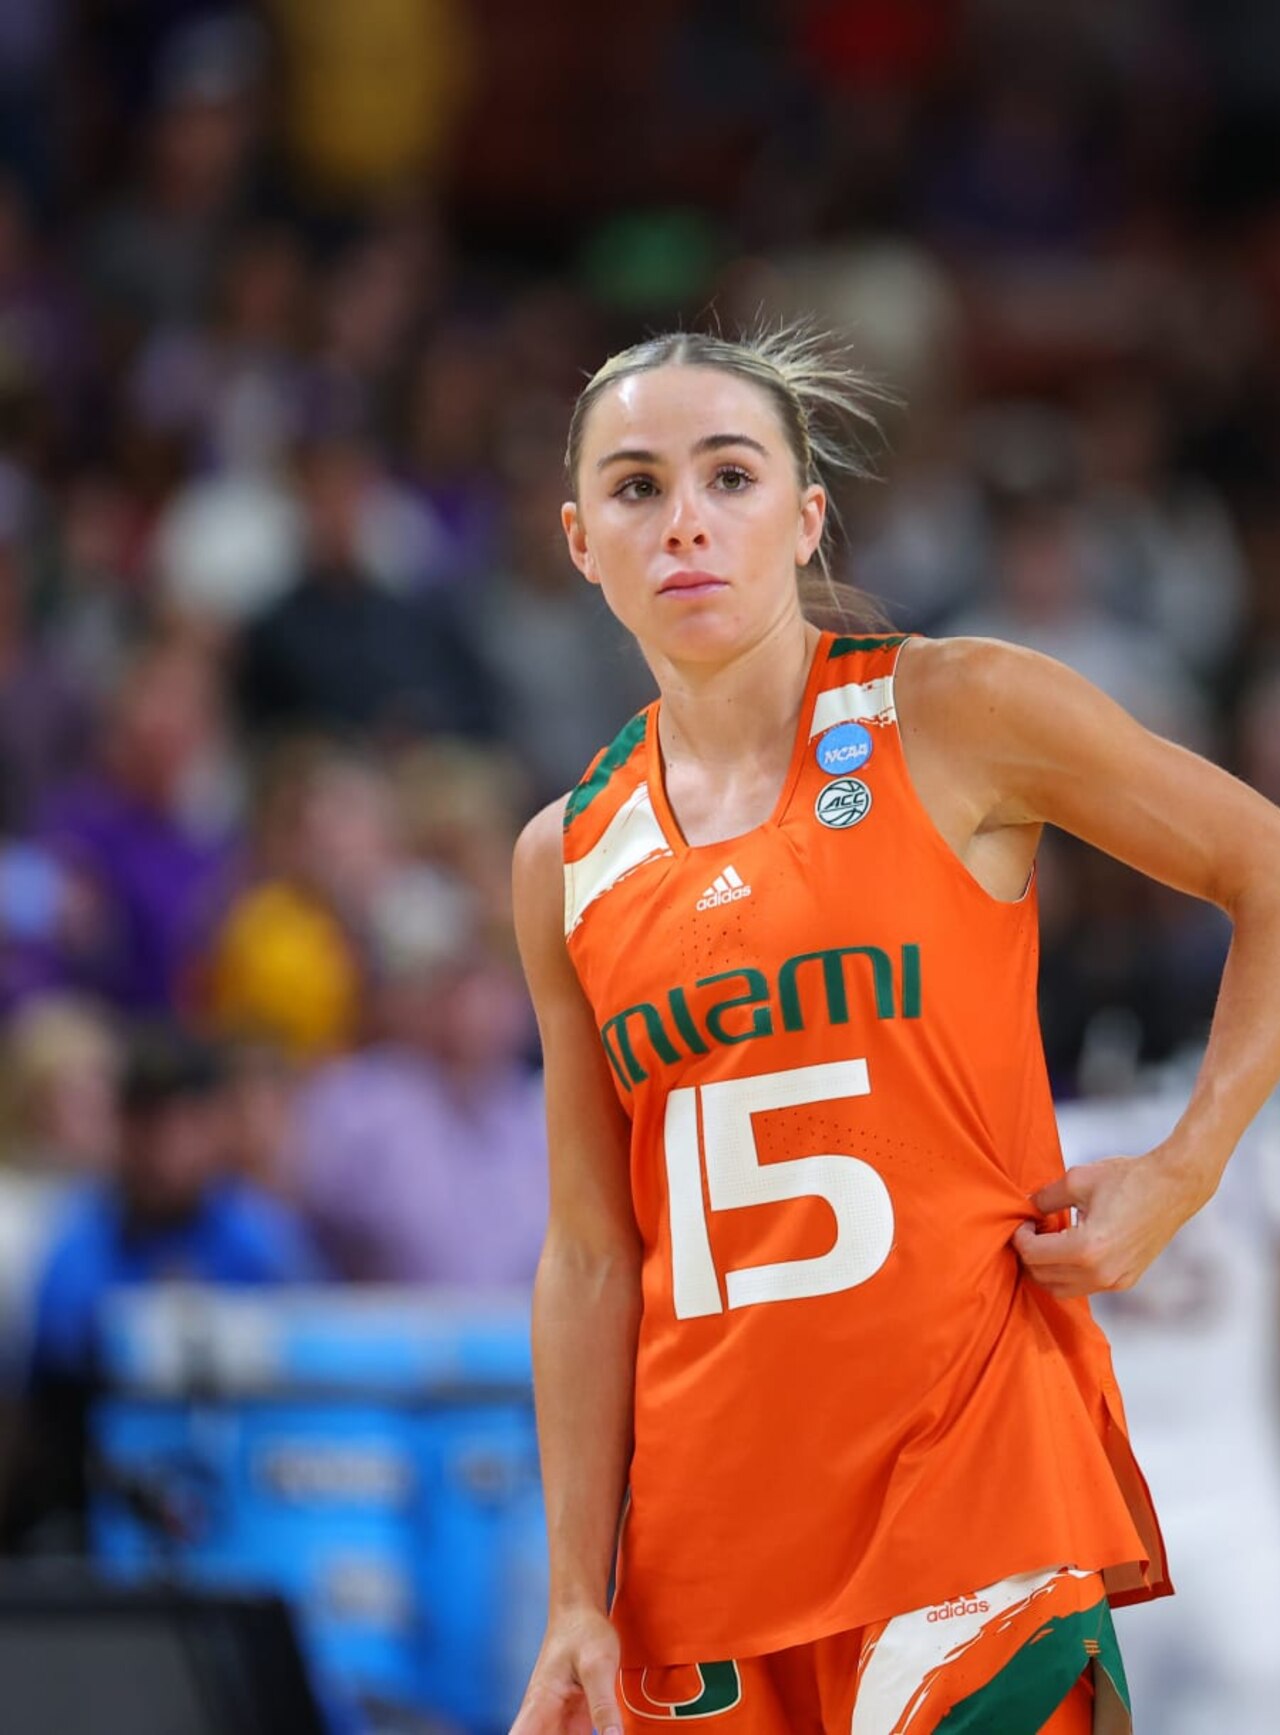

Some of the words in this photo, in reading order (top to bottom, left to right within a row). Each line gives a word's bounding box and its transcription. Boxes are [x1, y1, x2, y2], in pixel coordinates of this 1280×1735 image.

[824, 743, 868, 764] NCAA
[825, 793, 865, 810] ACC
[697, 885, 752, 911] adidas
[664, 1059, 894, 1320] 15
[926, 1599, 989, 1623] adidas
